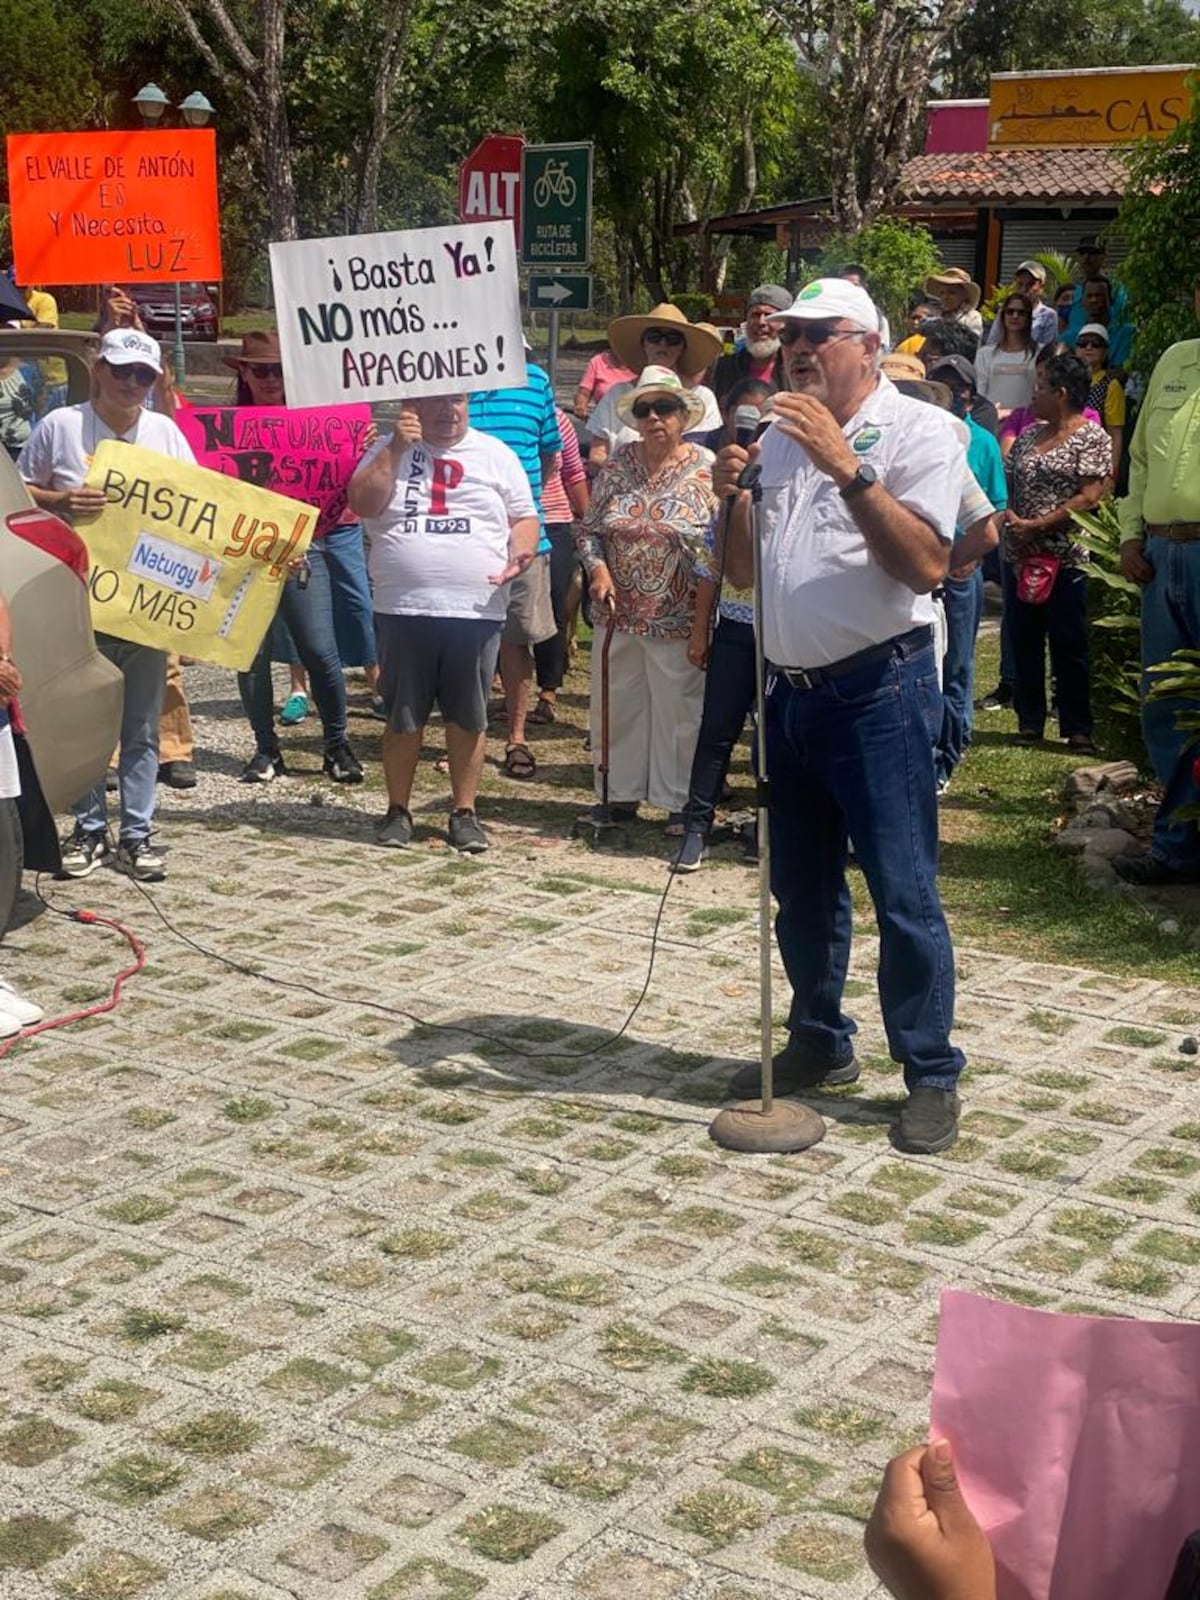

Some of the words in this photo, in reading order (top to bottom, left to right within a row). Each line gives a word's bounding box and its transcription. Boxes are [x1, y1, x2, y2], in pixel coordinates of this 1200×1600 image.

[26, 156, 45, 181] EL
[49, 155, 92, 178] VALLE
[104, 156, 125, 177] DE
[137, 151, 194, 177] ANTÓN
[100, 183, 125, 209] ES
[49, 213, 60, 237] Y
[72, 214, 166, 237] Necesita
[537, 224, 558, 238] RUTA
[559, 224, 572, 238] DE
[128, 239, 188, 272] LUZ
[444, 236, 495, 278] Ya!
[530, 241, 578, 255] BICICLETAS
[297, 302, 353, 345] NO
[342, 335, 505, 389] APAGONES!
[404, 449, 425, 533] SAILING
[428, 457, 464, 515] P
[102, 469, 219, 540] BASTA
[223, 512, 310, 581] ya!
[429, 519, 467, 532] 1993
[134, 543, 199, 589] Naturgy
[129, 583, 197, 631] MÁS
